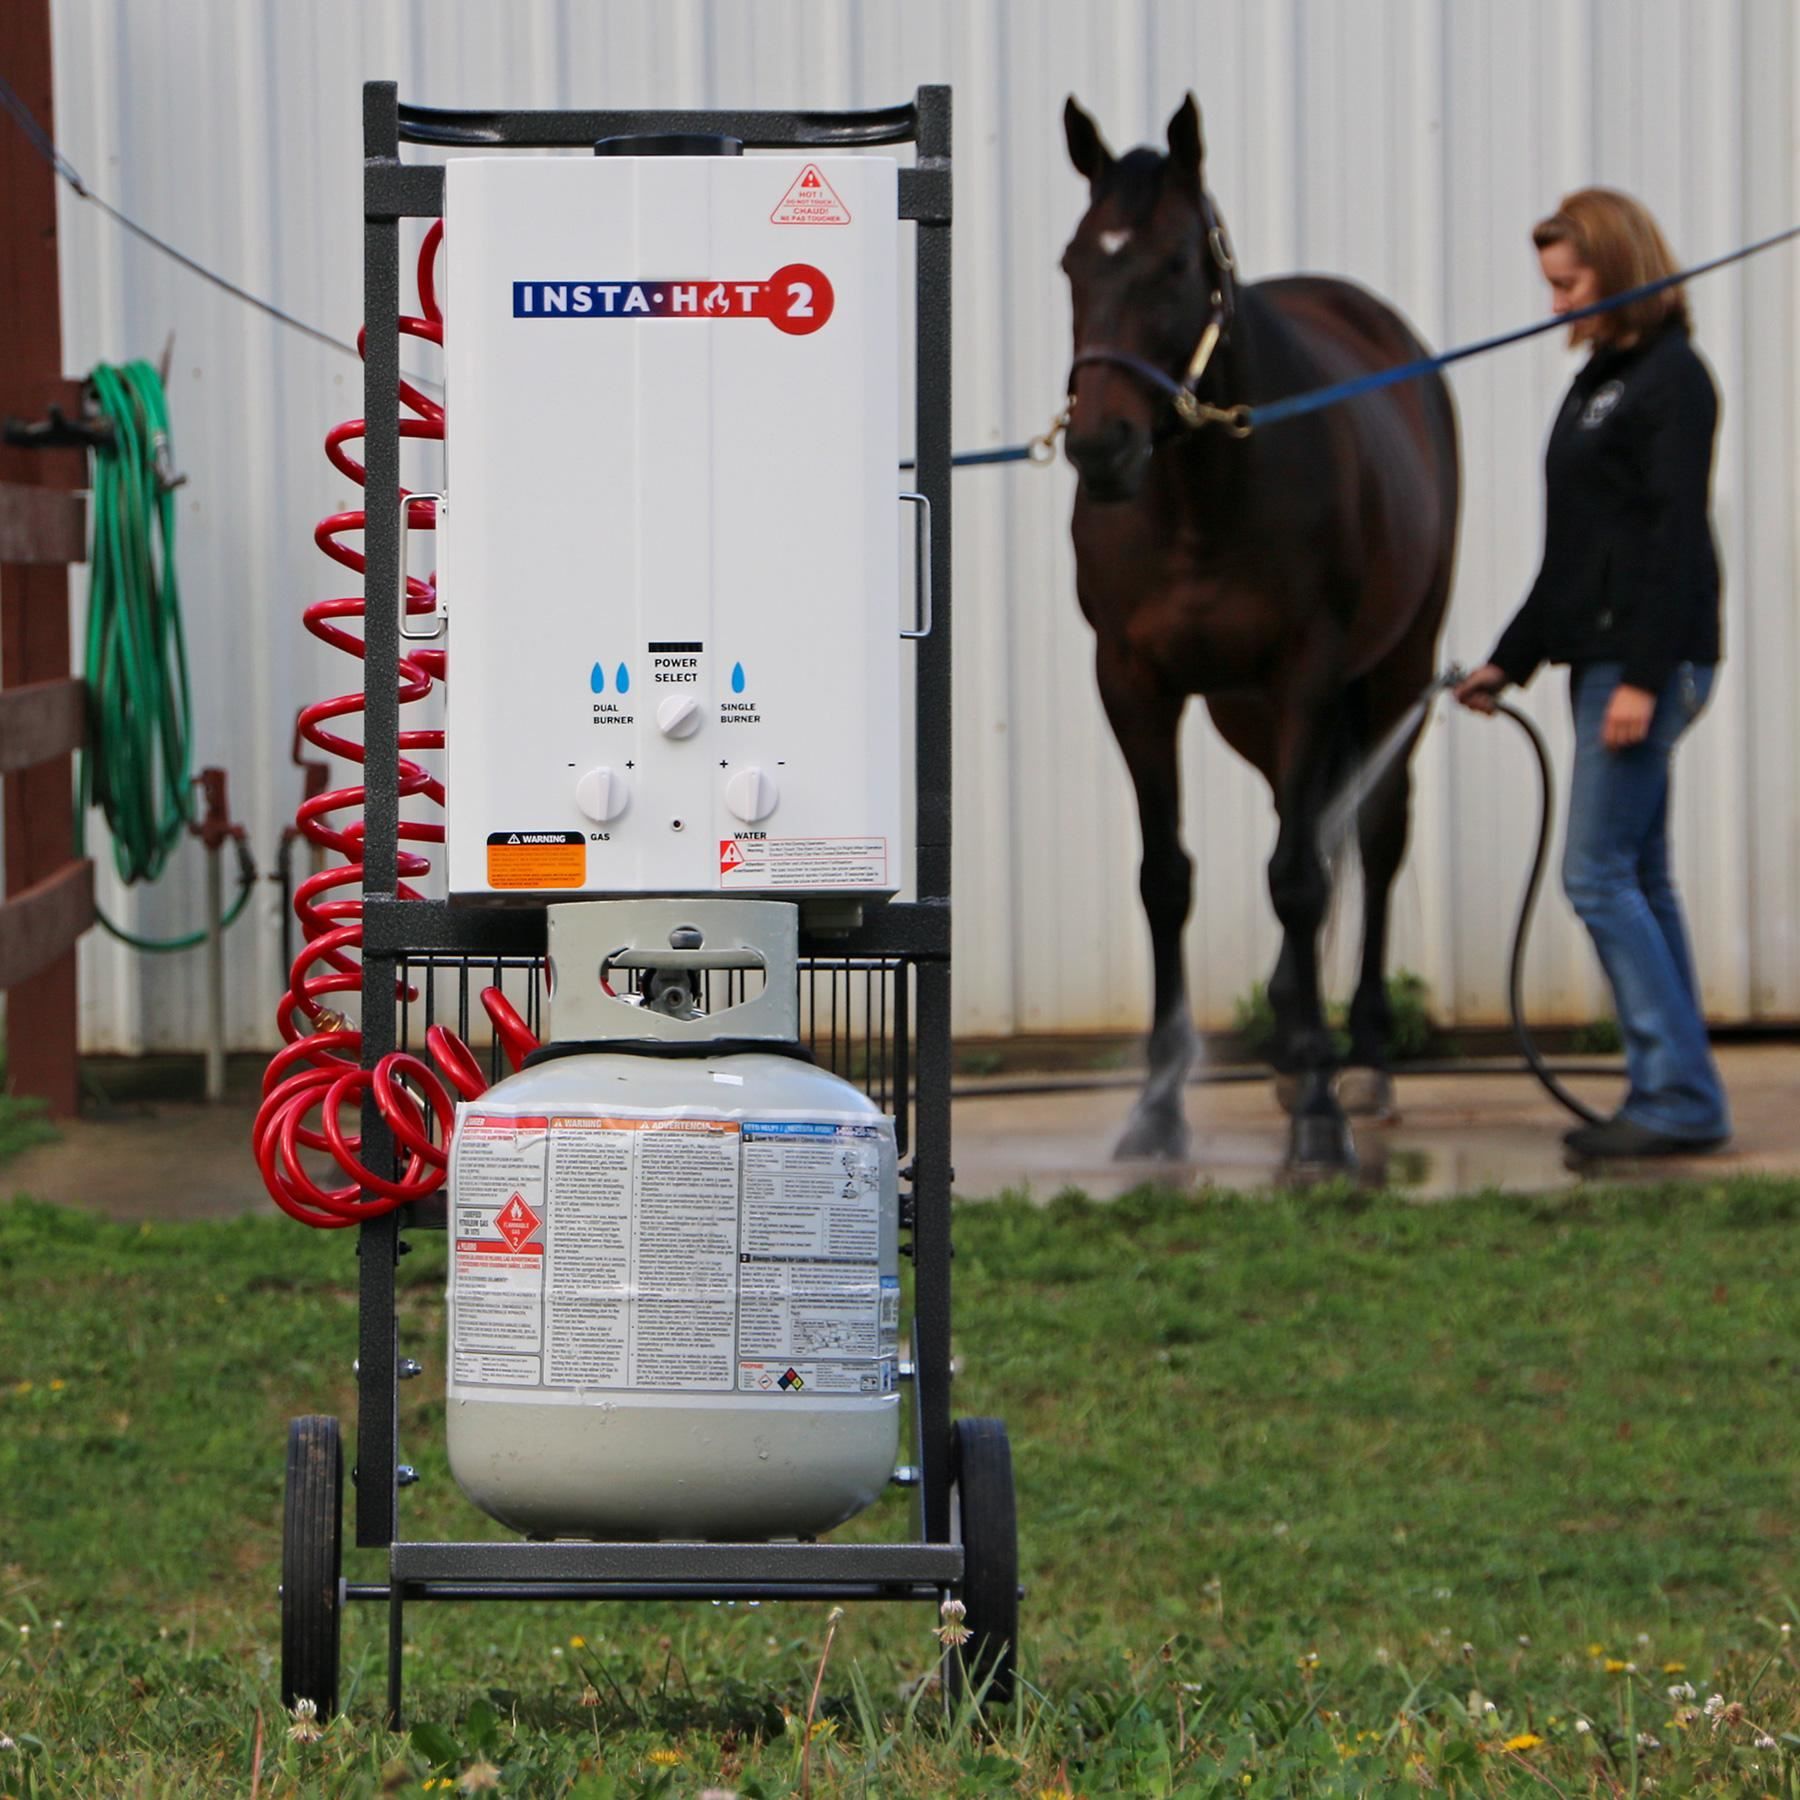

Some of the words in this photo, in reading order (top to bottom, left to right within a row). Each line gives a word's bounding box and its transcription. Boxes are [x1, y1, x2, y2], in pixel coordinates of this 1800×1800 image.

[786, 282, 814, 317] 2
[654, 658, 697, 668] POWER
[654, 673, 698, 682] SELECT
[593, 704, 619, 712] DUAL
[720, 703, 756, 711] SINGLE
[593, 716, 634, 724] BURNER
[720, 715, 761, 723] BURNER
[522, 835, 566, 844] WARNING
[590, 833, 610, 841] GAS
[734, 832, 767, 840] WATER
